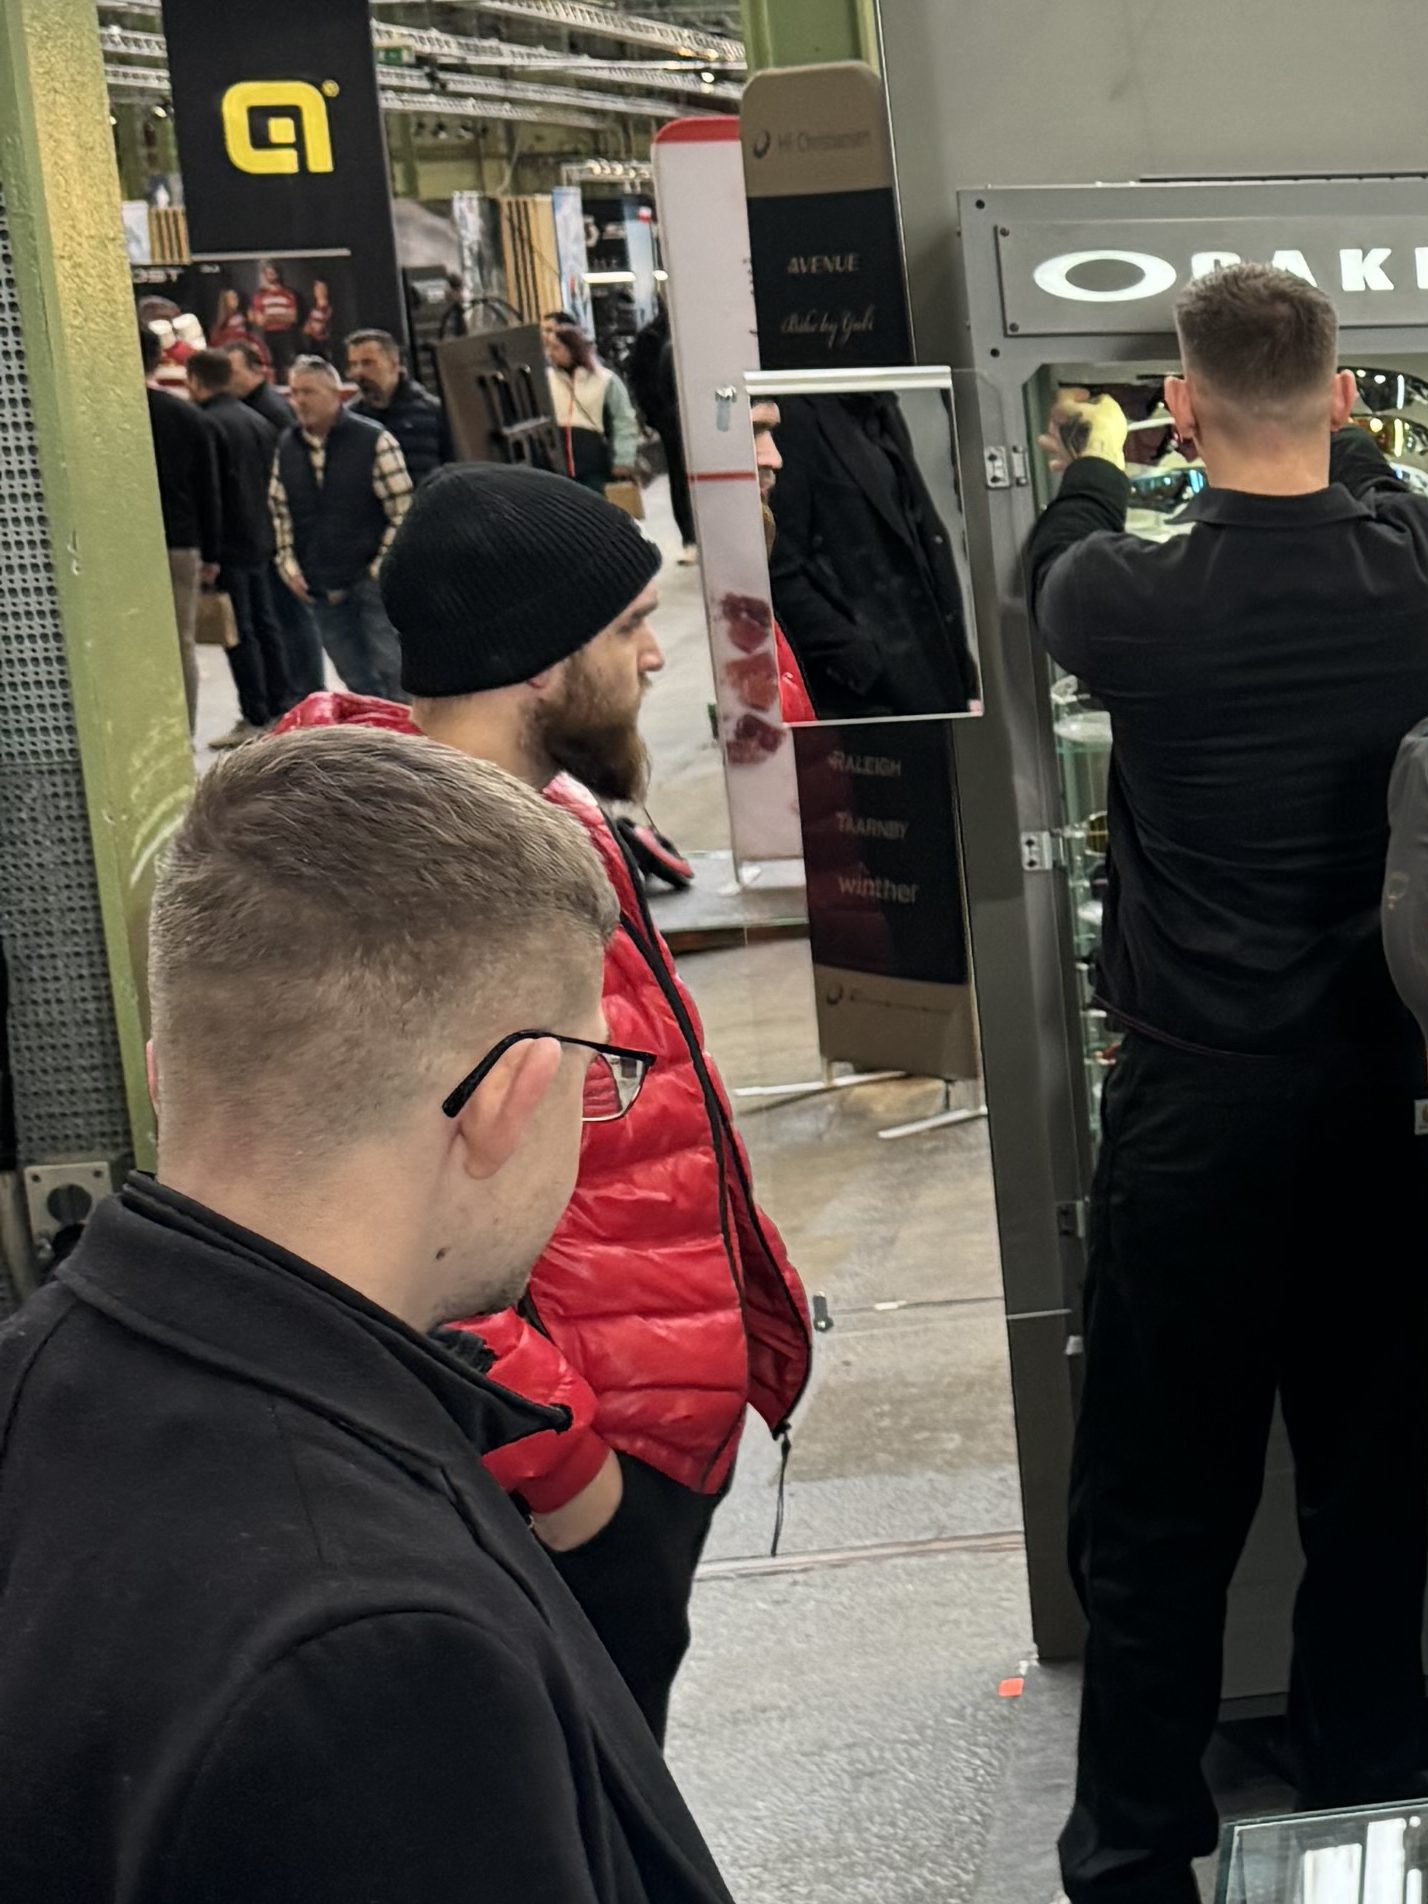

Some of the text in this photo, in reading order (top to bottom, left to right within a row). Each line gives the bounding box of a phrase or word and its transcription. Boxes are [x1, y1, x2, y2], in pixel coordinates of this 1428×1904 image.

[788, 255, 858, 274] AVENUE
[829, 751, 901, 776] RALEIGH
[838, 875, 919, 903] winther
